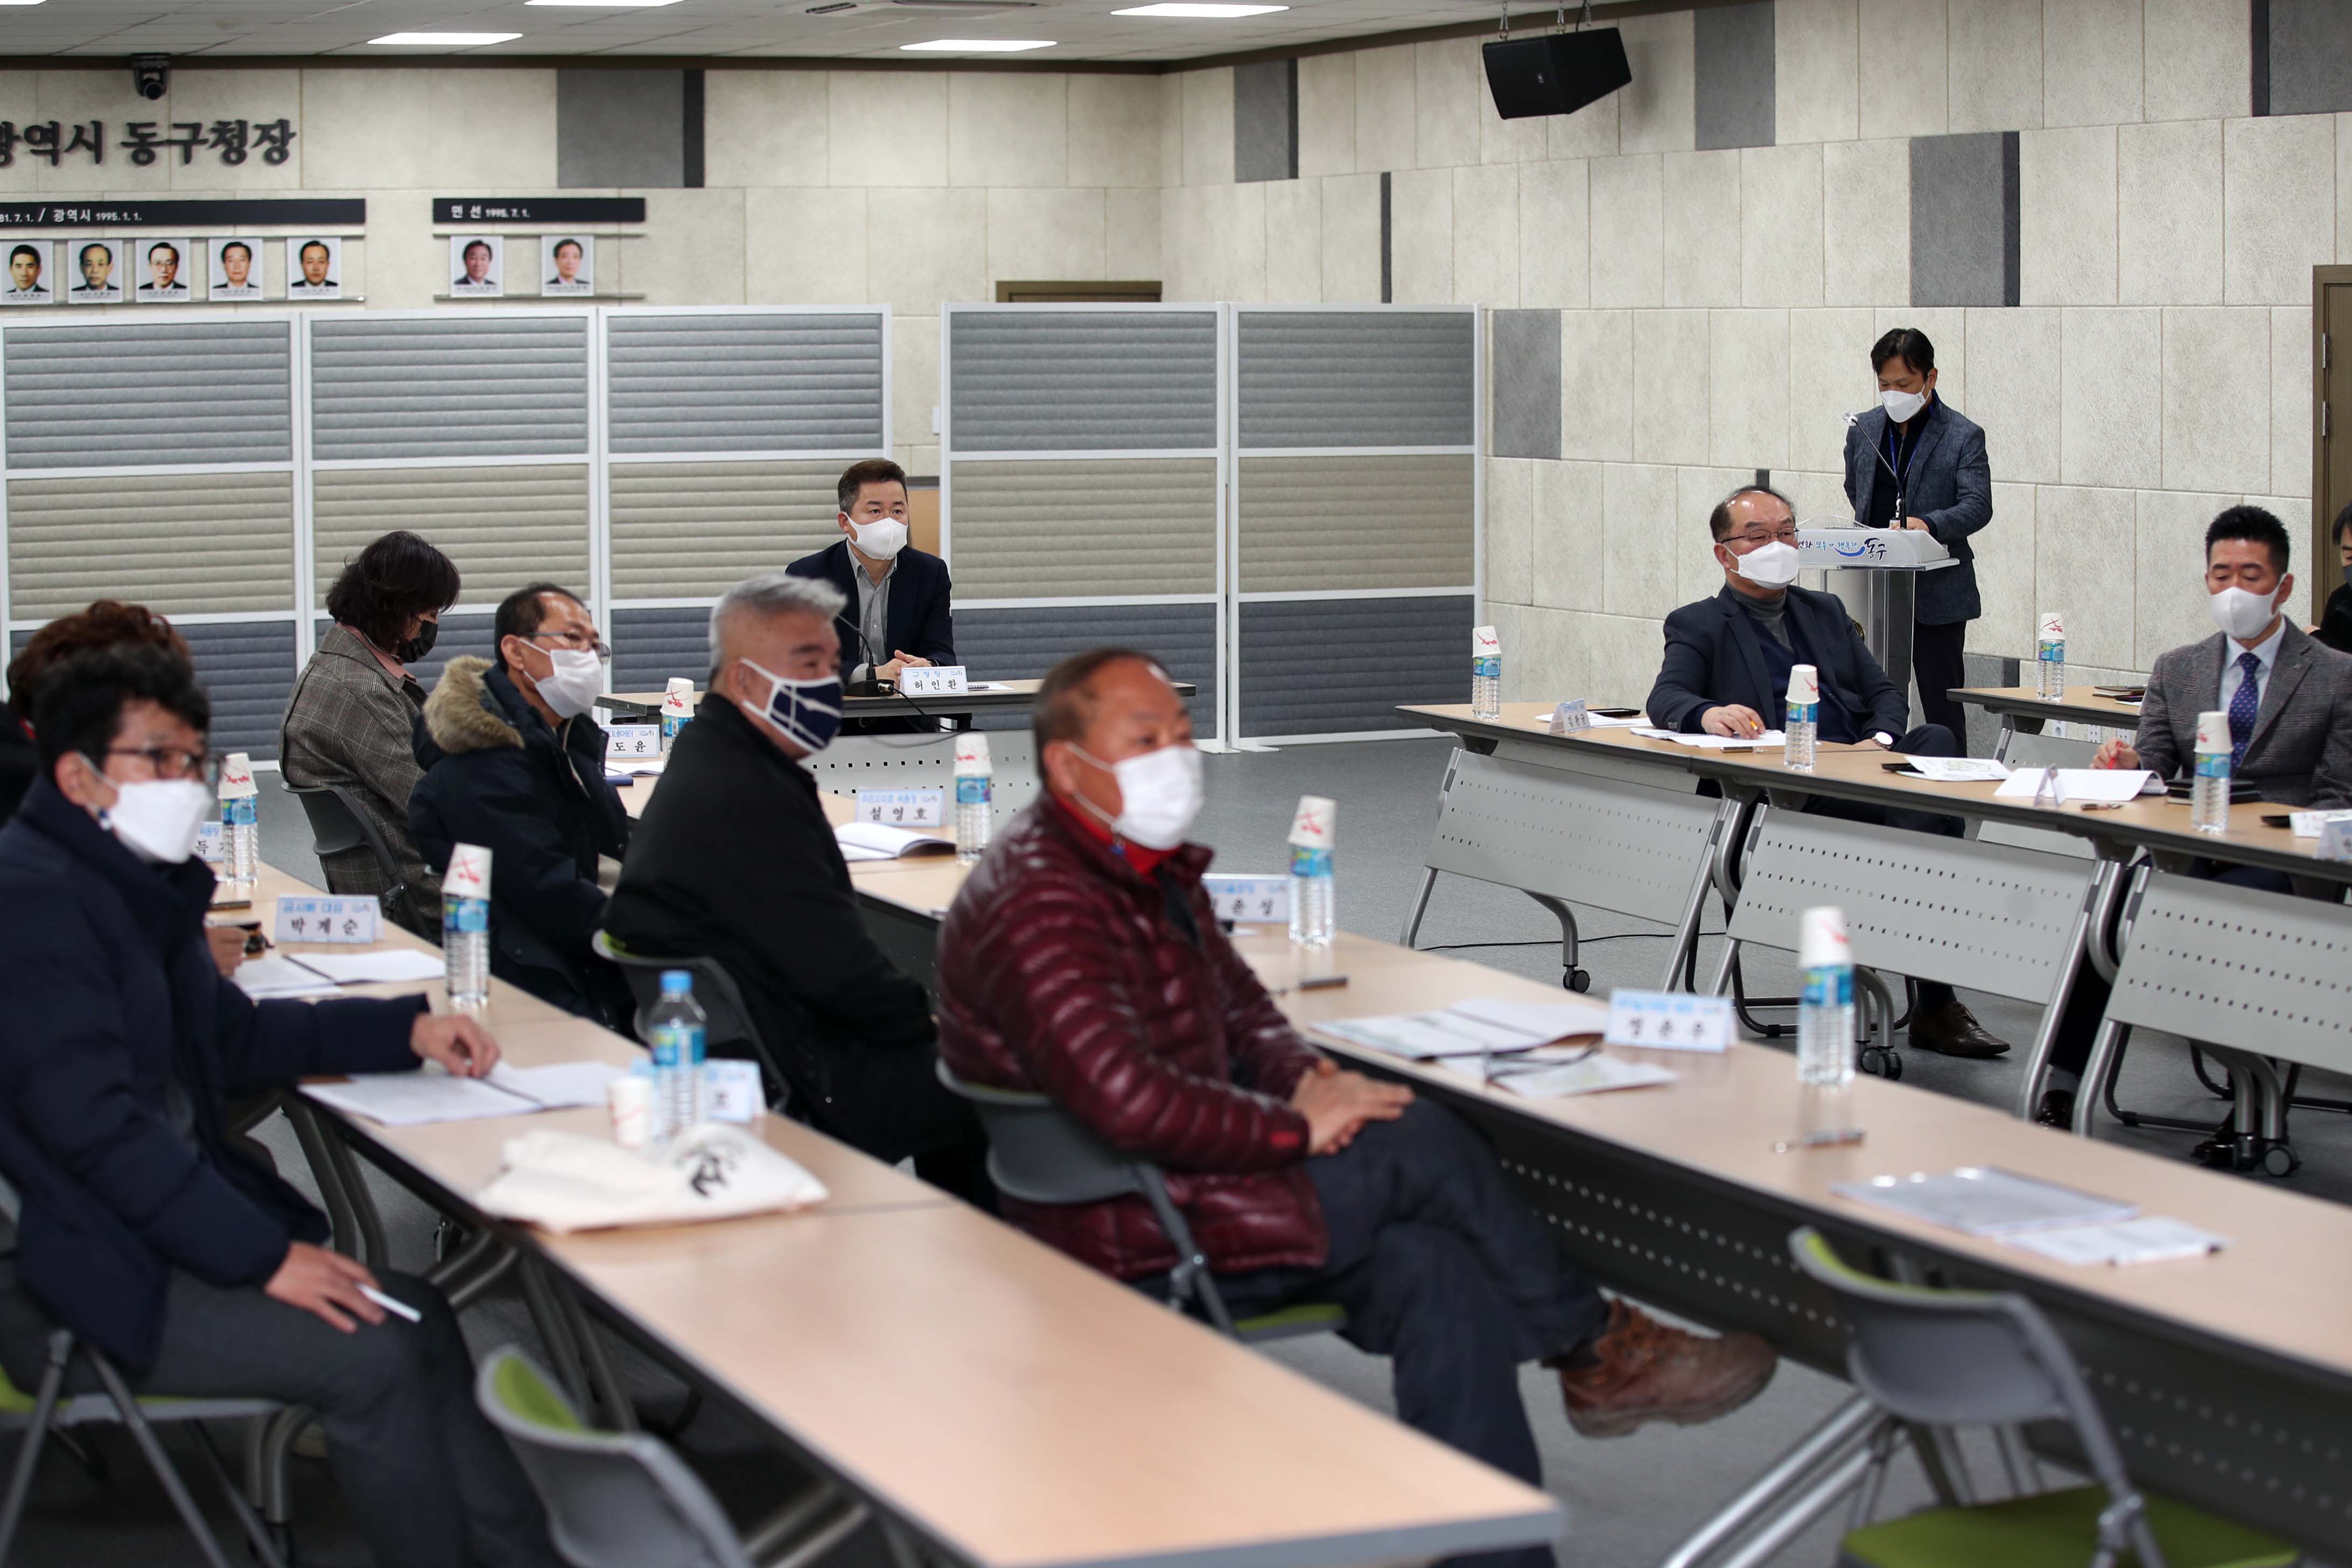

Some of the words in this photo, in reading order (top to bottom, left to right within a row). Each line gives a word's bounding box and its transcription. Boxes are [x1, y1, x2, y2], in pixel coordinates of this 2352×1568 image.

[121, 118, 296, 166] 동구청장
[53, 208, 91, 222] 광역시
[1865, 538, 1887, 561] 동구
[914, 678, 957, 691] 허인환
